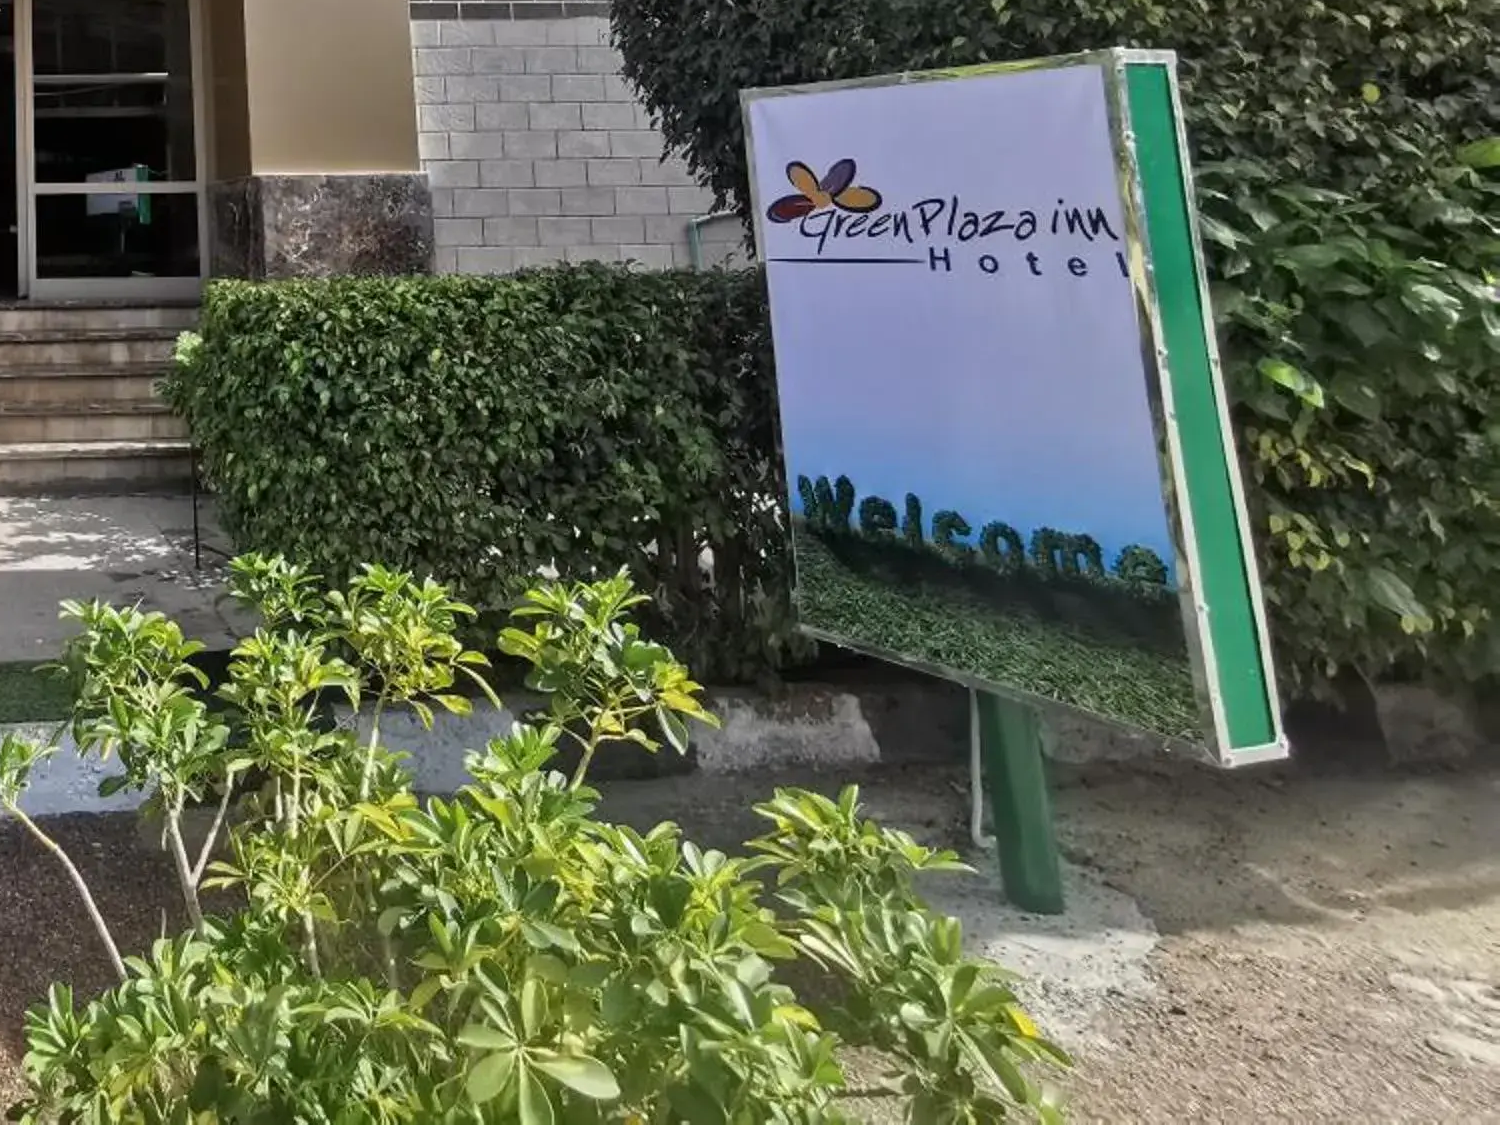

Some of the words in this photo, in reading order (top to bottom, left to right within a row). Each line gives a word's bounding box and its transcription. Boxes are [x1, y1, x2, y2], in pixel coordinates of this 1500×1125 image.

[1051, 198, 1121, 241] inn
[928, 246, 1130, 277] Hotel
[798, 473, 1168, 587] Welcome
